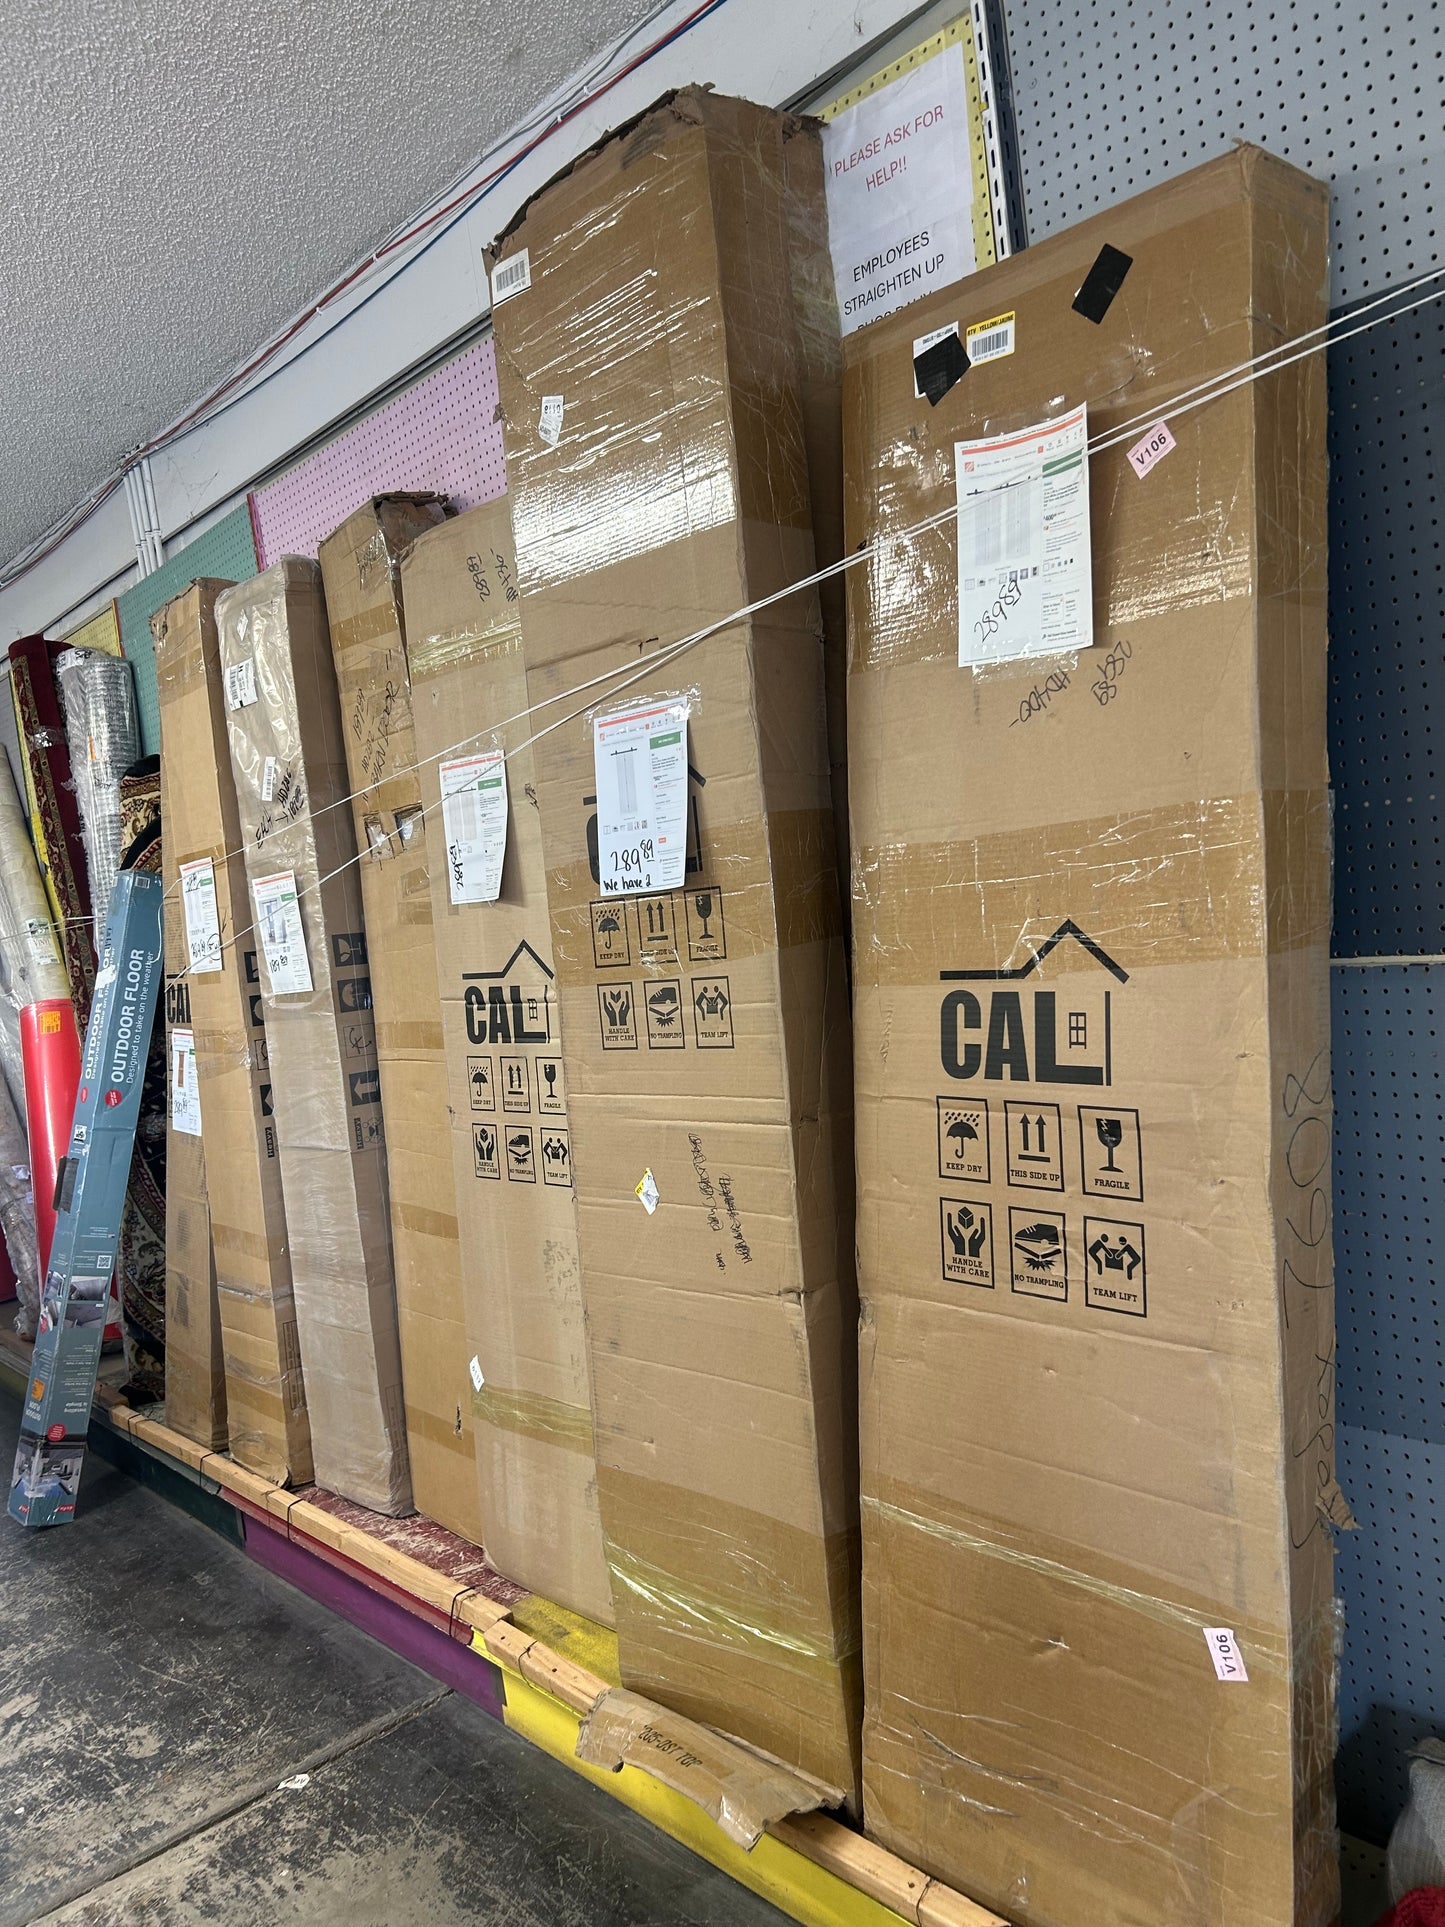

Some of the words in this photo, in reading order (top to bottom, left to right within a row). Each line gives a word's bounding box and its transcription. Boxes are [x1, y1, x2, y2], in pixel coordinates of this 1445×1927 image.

[834, 138, 881, 177] PLEASE
[884, 122, 911, 150] ASK
[914, 104, 944, 134] FOR
[865, 156, 907, 192] HELP!!
[853, 231, 930, 282] EMPLOYEES
[844, 264, 921, 316] STRAIGHTEN
[925, 253, 944, 275] UP
[1136, 433, 1167, 465] V106
[603, 879, 619, 892] We
[621, 876, 643, 890] have
[645, 874, 651, 887] 2
[143, 951, 154, 985] weather
[140, 986, 149, 1000] the
[85, 1002, 103, 1080] OUTDOOR
[97, 947, 112, 1000] FOR
[111, 1005, 136, 1083] OUTDOOR
[124, 948, 145, 1001] FLOOR
[139, 1001, 146, 1012] on
[464, 986, 547, 1044] CAL
[135, 1013, 144, 1032] take
[133, 1034, 141, 1044] to
[940, 989, 1104, 1086] CAL
[126, 1045, 139, 1084] Designed
[946, 1163, 965, 1172] KEEP
[967, 1164, 982, 1173] DRY
[1010, 1169, 1028, 1178] THIS
[1029, 1171, 1047, 1180] SIDE
[1049, 1173, 1060, 1182] UP
[1094, 1178, 1130, 1190] FRAGILE
[946, 1264, 966, 1275] WITH
[968, 1267, 990, 1278] CARE
[952, 1257, 983, 1269] HANDLE
[1014, 1274, 1024, 1282] NO
[1025, 1275, 1064, 1289] TRAMPLING
[1093, 1288, 1117, 1299] TEAM
[1118, 1291, 1138, 1303] LIFT
[1216, 1634, 1236, 1673] V106
